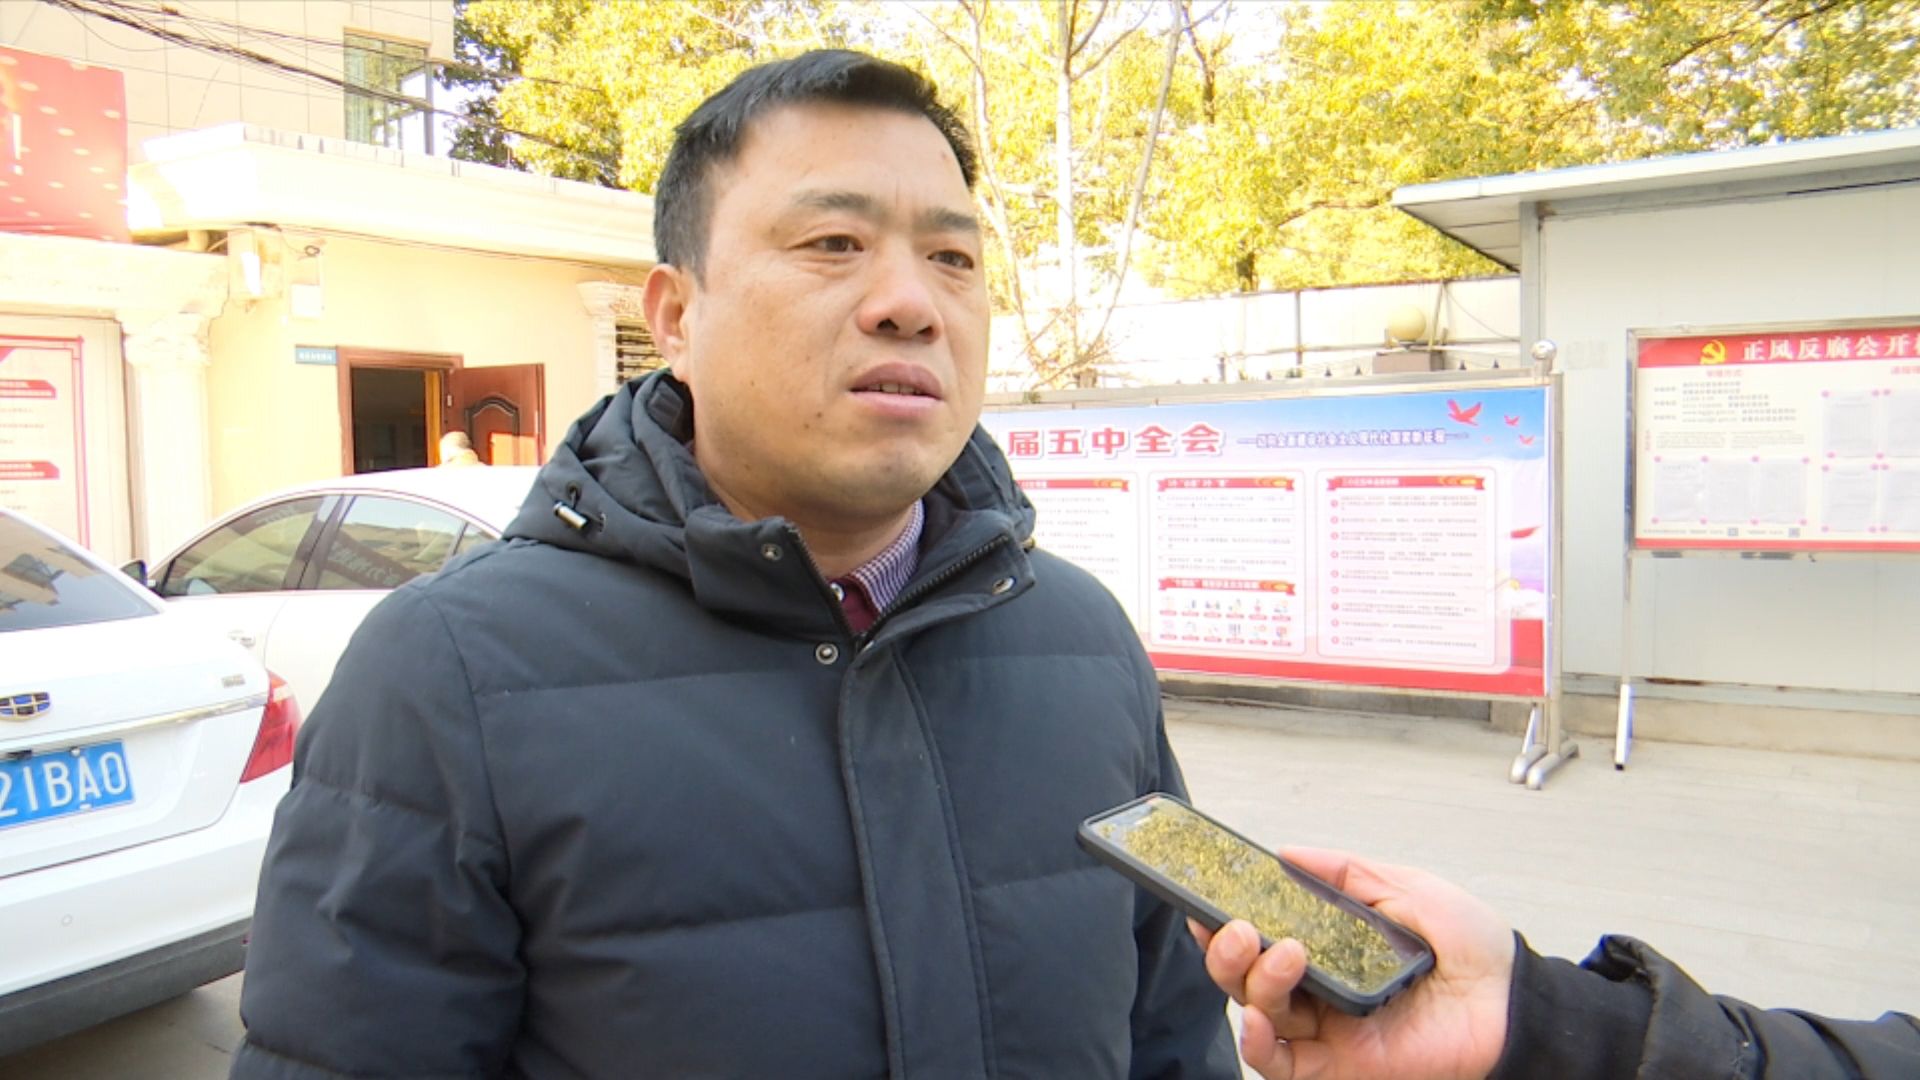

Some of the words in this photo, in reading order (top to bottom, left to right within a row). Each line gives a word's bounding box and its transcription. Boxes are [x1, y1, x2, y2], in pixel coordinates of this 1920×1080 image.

[1743, 333, 1920, 361] 正风反腐公开
[1007, 424, 1220, 456] 届五中全会
